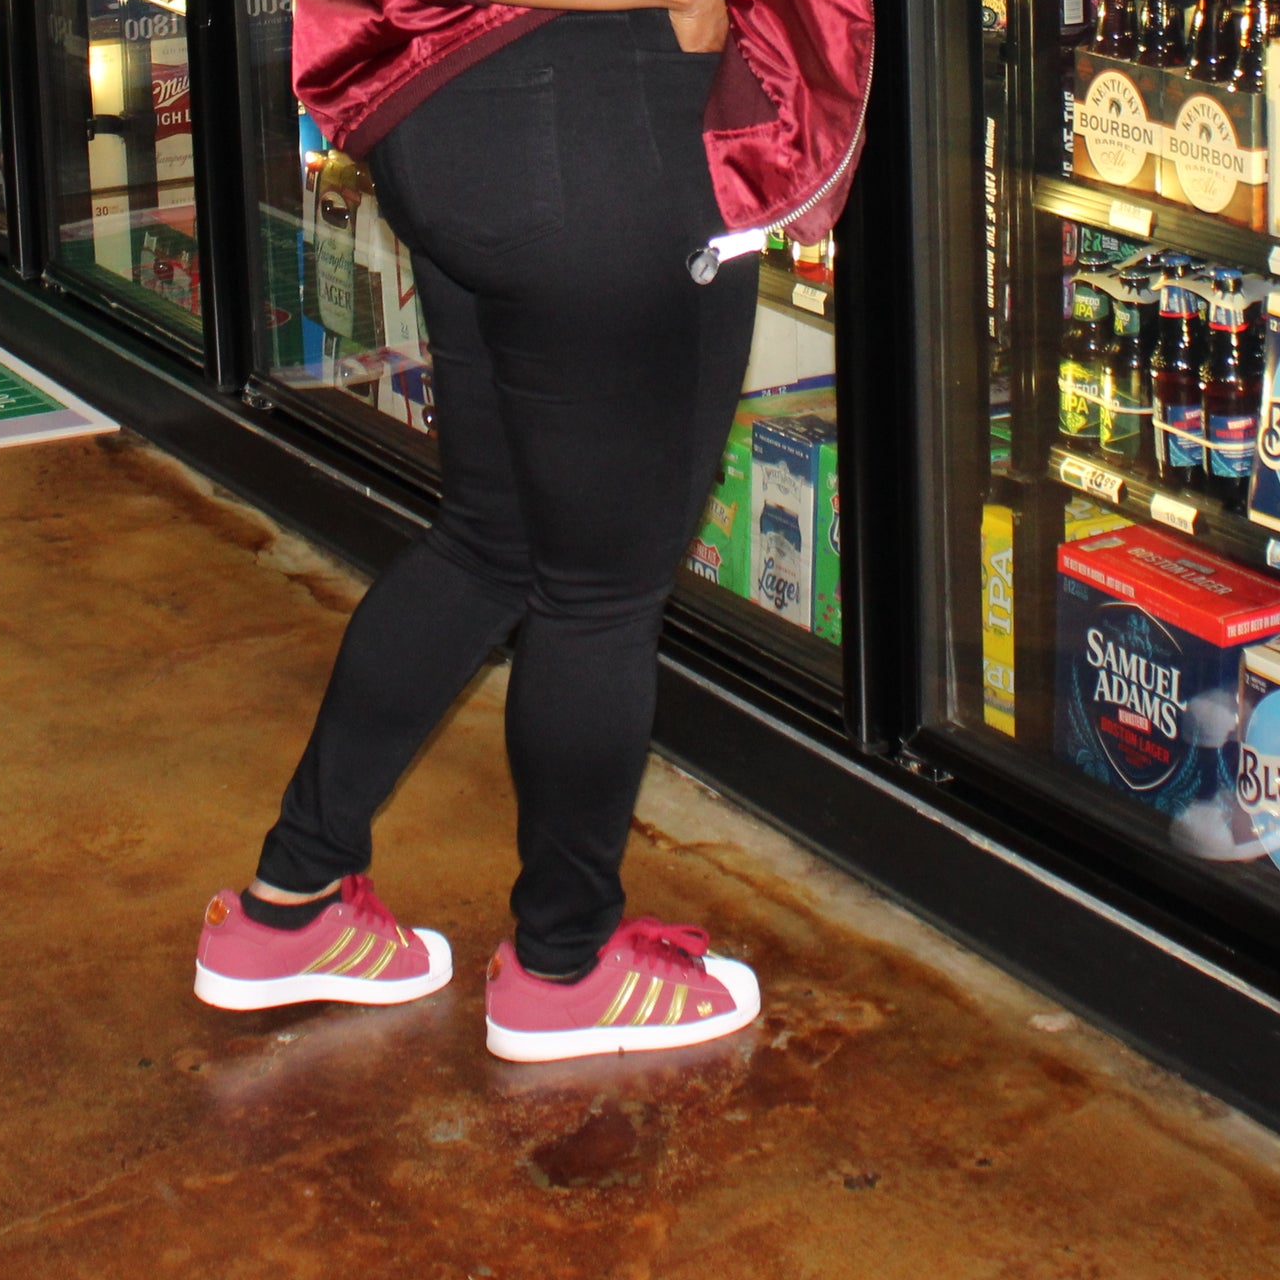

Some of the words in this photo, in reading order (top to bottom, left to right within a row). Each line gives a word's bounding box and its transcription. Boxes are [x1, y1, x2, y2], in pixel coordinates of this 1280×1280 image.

[1091, 78, 1142, 118] KENTUCKY
[1080, 112, 1153, 146] BOURBON
[1182, 104, 1231, 142] KENTUCKY
[1170, 137, 1244, 174] BOURBON
[758, 556, 800, 609] Lager
[988, 546, 1012, 635] IPA
[1086, 628, 1187, 712] SAMUEL
[1094, 670, 1177, 739] ADAMS
